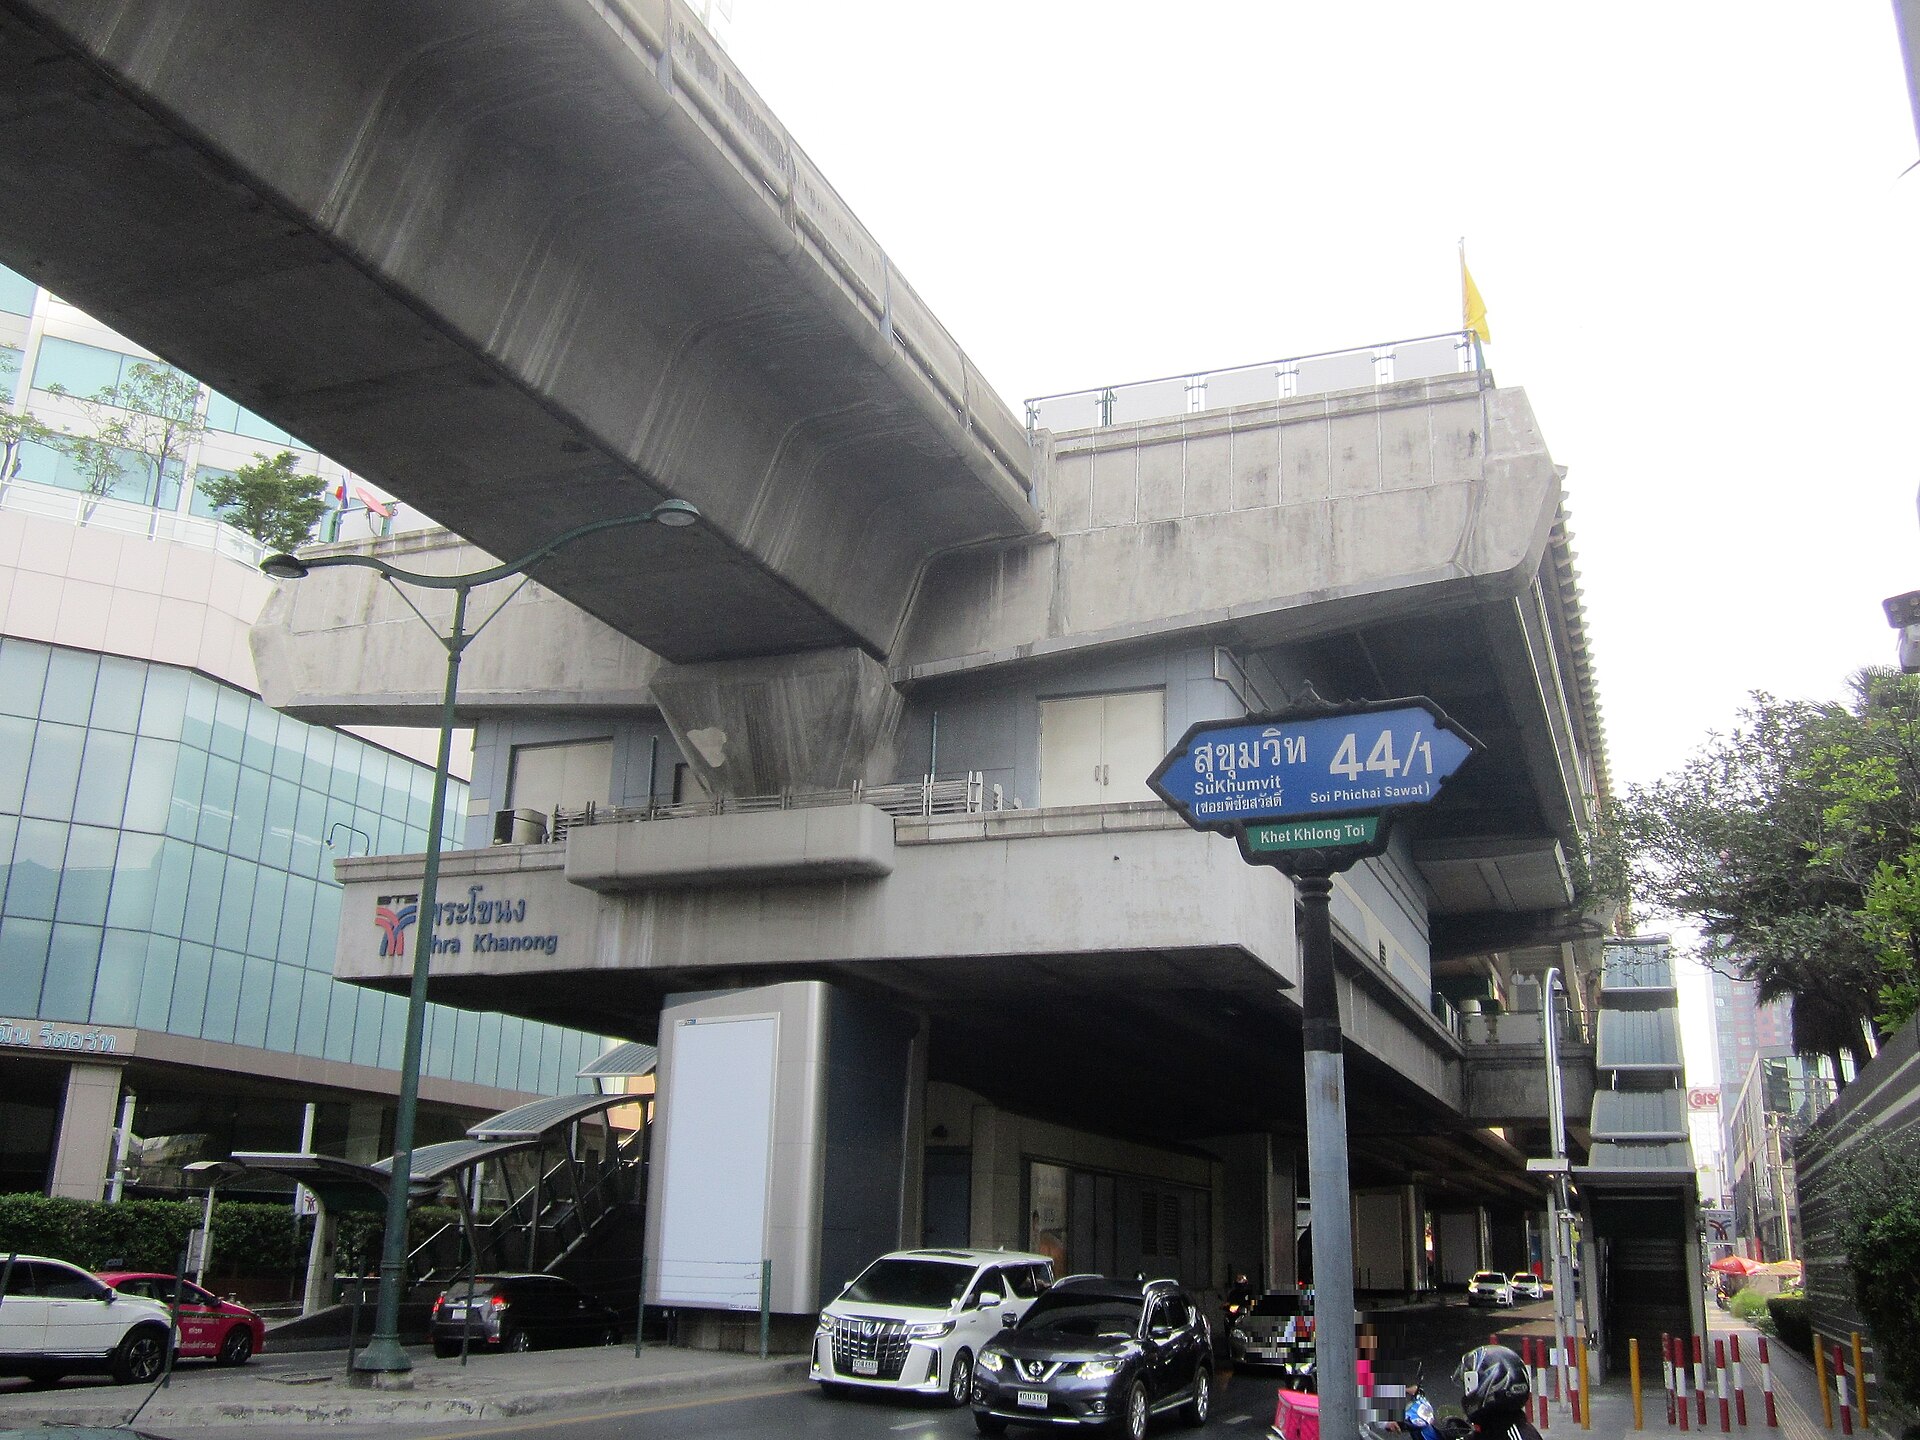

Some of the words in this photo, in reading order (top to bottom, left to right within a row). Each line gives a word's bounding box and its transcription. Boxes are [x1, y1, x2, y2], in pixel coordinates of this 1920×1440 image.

[1195, 728, 1307, 782] สุขุมวิท
[1329, 730, 1433, 781] 44/1
[1310, 791, 1330, 803] Soi
[1334, 786, 1381, 802] Phichai
[1261, 829, 1291, 844] Khet
[1294, 827, 1341, 841] Khlong
[1344, 824, 1365, 837] Toi
[473, 931, 558, 956] Khanong
